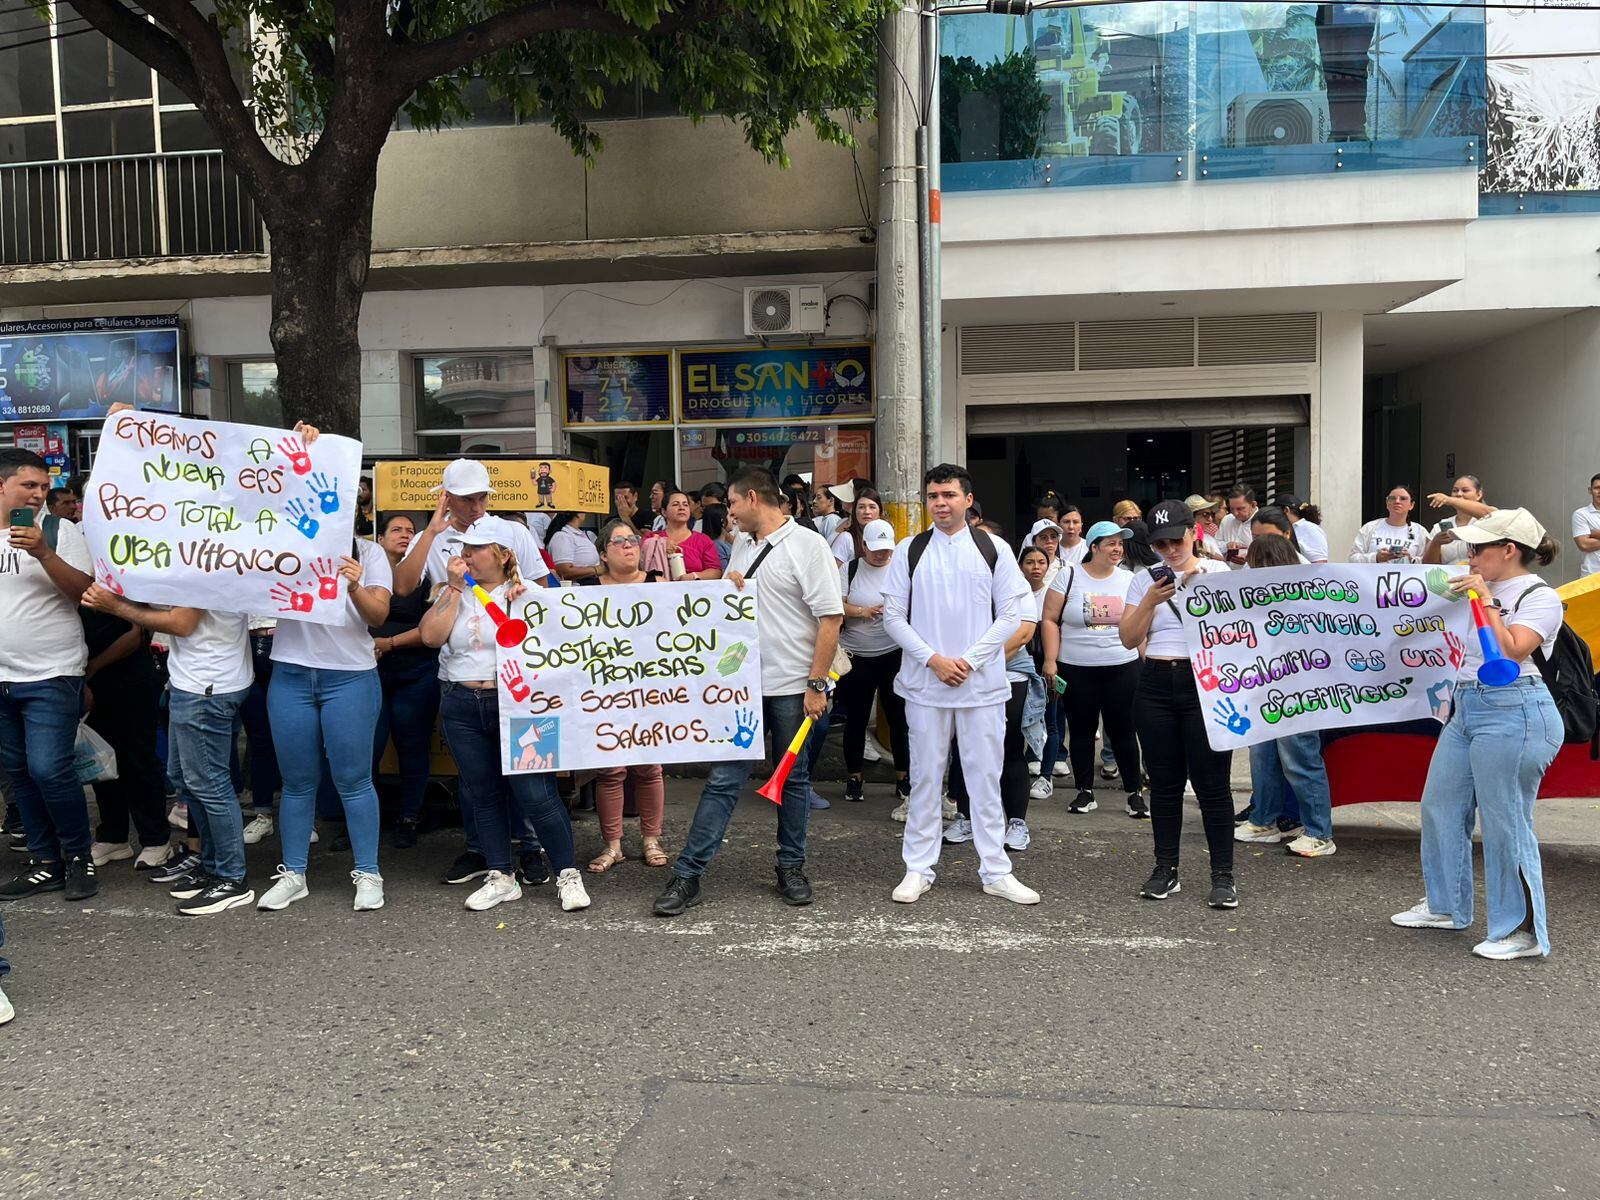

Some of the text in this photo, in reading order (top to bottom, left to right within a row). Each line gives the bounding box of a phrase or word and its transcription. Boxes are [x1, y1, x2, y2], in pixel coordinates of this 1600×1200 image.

[73, 320, 93, 330] para
[688, 363, 730, 394] EL
[2, 406, 16, 415] 324
[785, 396, 795, 407] &
[800, 392, 866, 407] LICORES
[247, 438, 275, 464] A
[143, 454, 284, 494] NUEVA EPS
[487, 466, 499, 475] tte
[489, 480, 521, 488] resso
[99, 482, 278, 535] PAGO TOTAL A
[400, 491, 529, 502] Capucci ericano
[585, 491, 597, 503] CON
[1155, 509, 1170, 525] NY
[110, 534, 172, 569] UBA
[1239, 577, 1360, 609] recursos
[1376, 571, 1428, 609] NO
[561, 592, 655, 629] SALUD
[676, 593, 711, 626] NO
[723, 593, 755, 621] SE
[1199, 619, 1258, 649] hay
[522, 628, 716, 669] SOSTIENE CON
[1345, 649, 1386, 672] es
[582, 655, 705, 686] PROMESAS
[530, 684, 750, 714] SE SOSTIENE CON
